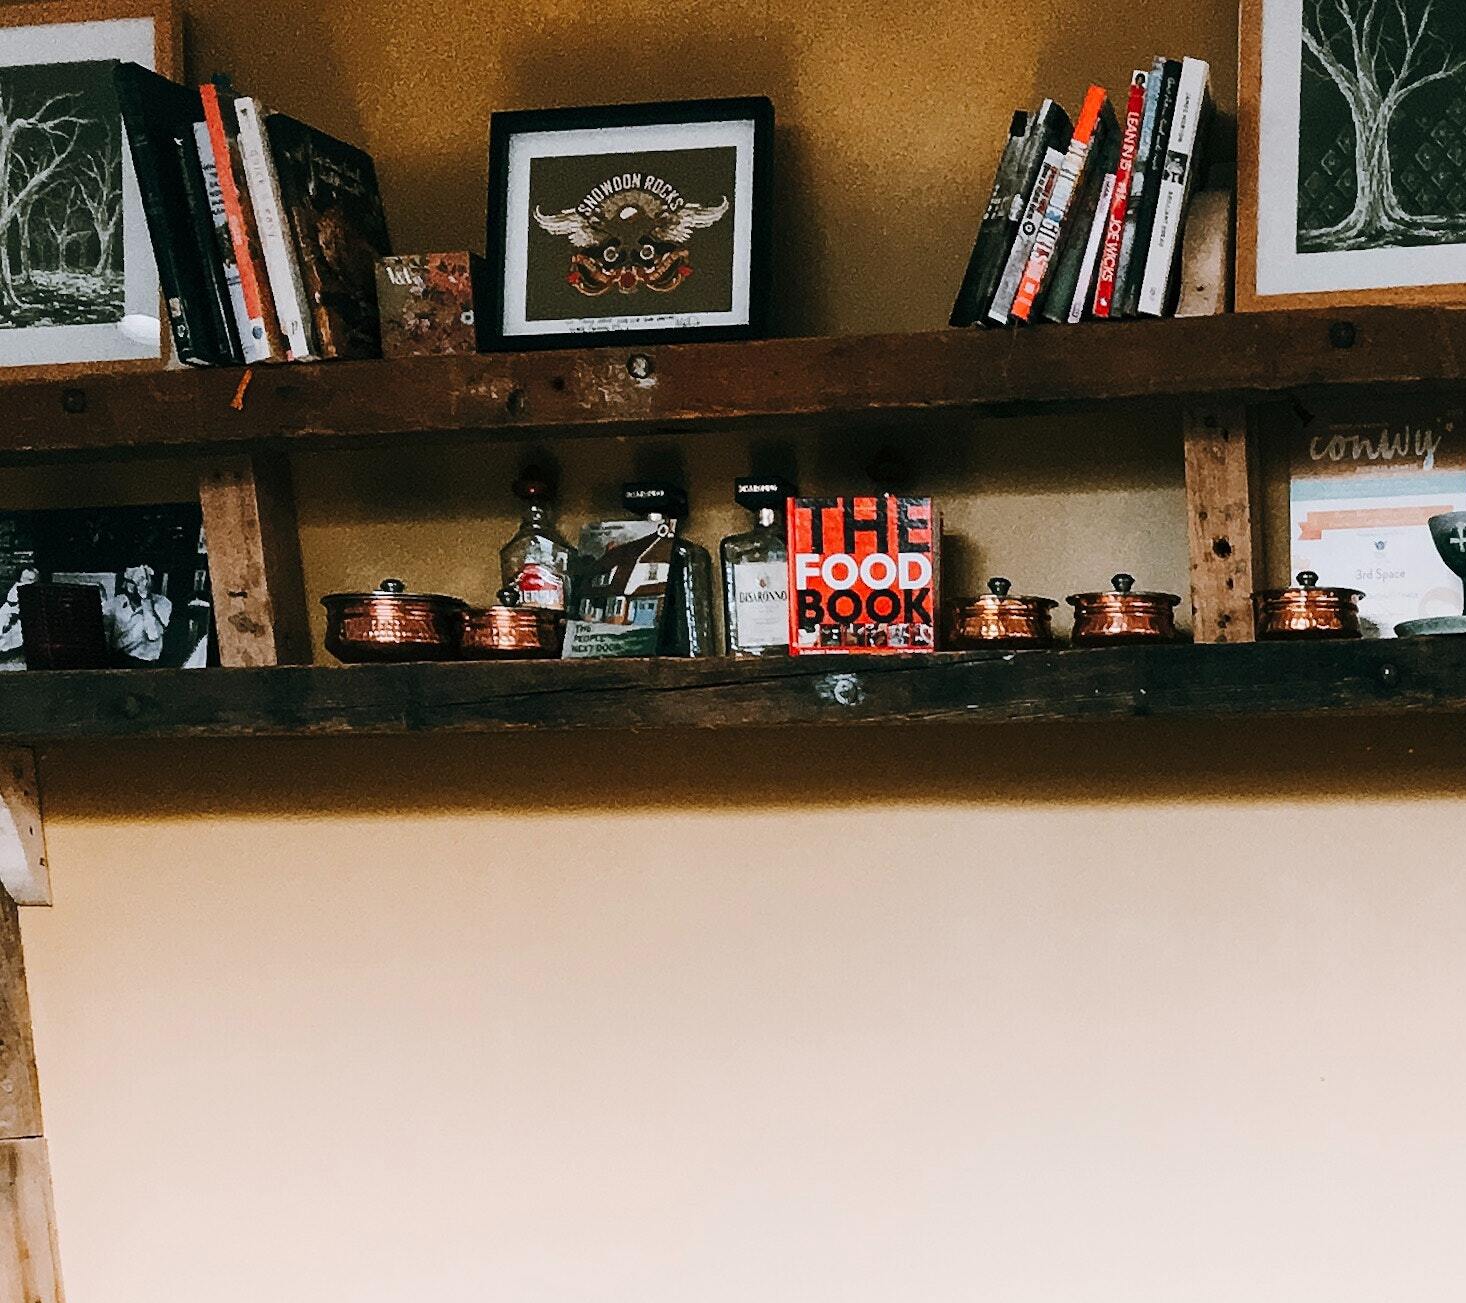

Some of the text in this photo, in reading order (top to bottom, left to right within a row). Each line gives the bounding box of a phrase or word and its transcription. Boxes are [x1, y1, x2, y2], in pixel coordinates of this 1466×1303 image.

[1124, 111, 1140, 144] LEAN
[577, 172, 685, 217] SNOWDON ROCKS
[1107, 214, 1122, 241] JOE
[1101, 239, 1118, 282] WICKS
[1309, 424, 1442, 471] conwy
[796, 497, 931, 554] THE
[795, 552, 933, 591] FOOD
[1355, 567, 1406, 584] 3rd Space
[739, 590, 788, 603] DISARONNO
[798, 588, 933, 627] BOOK
